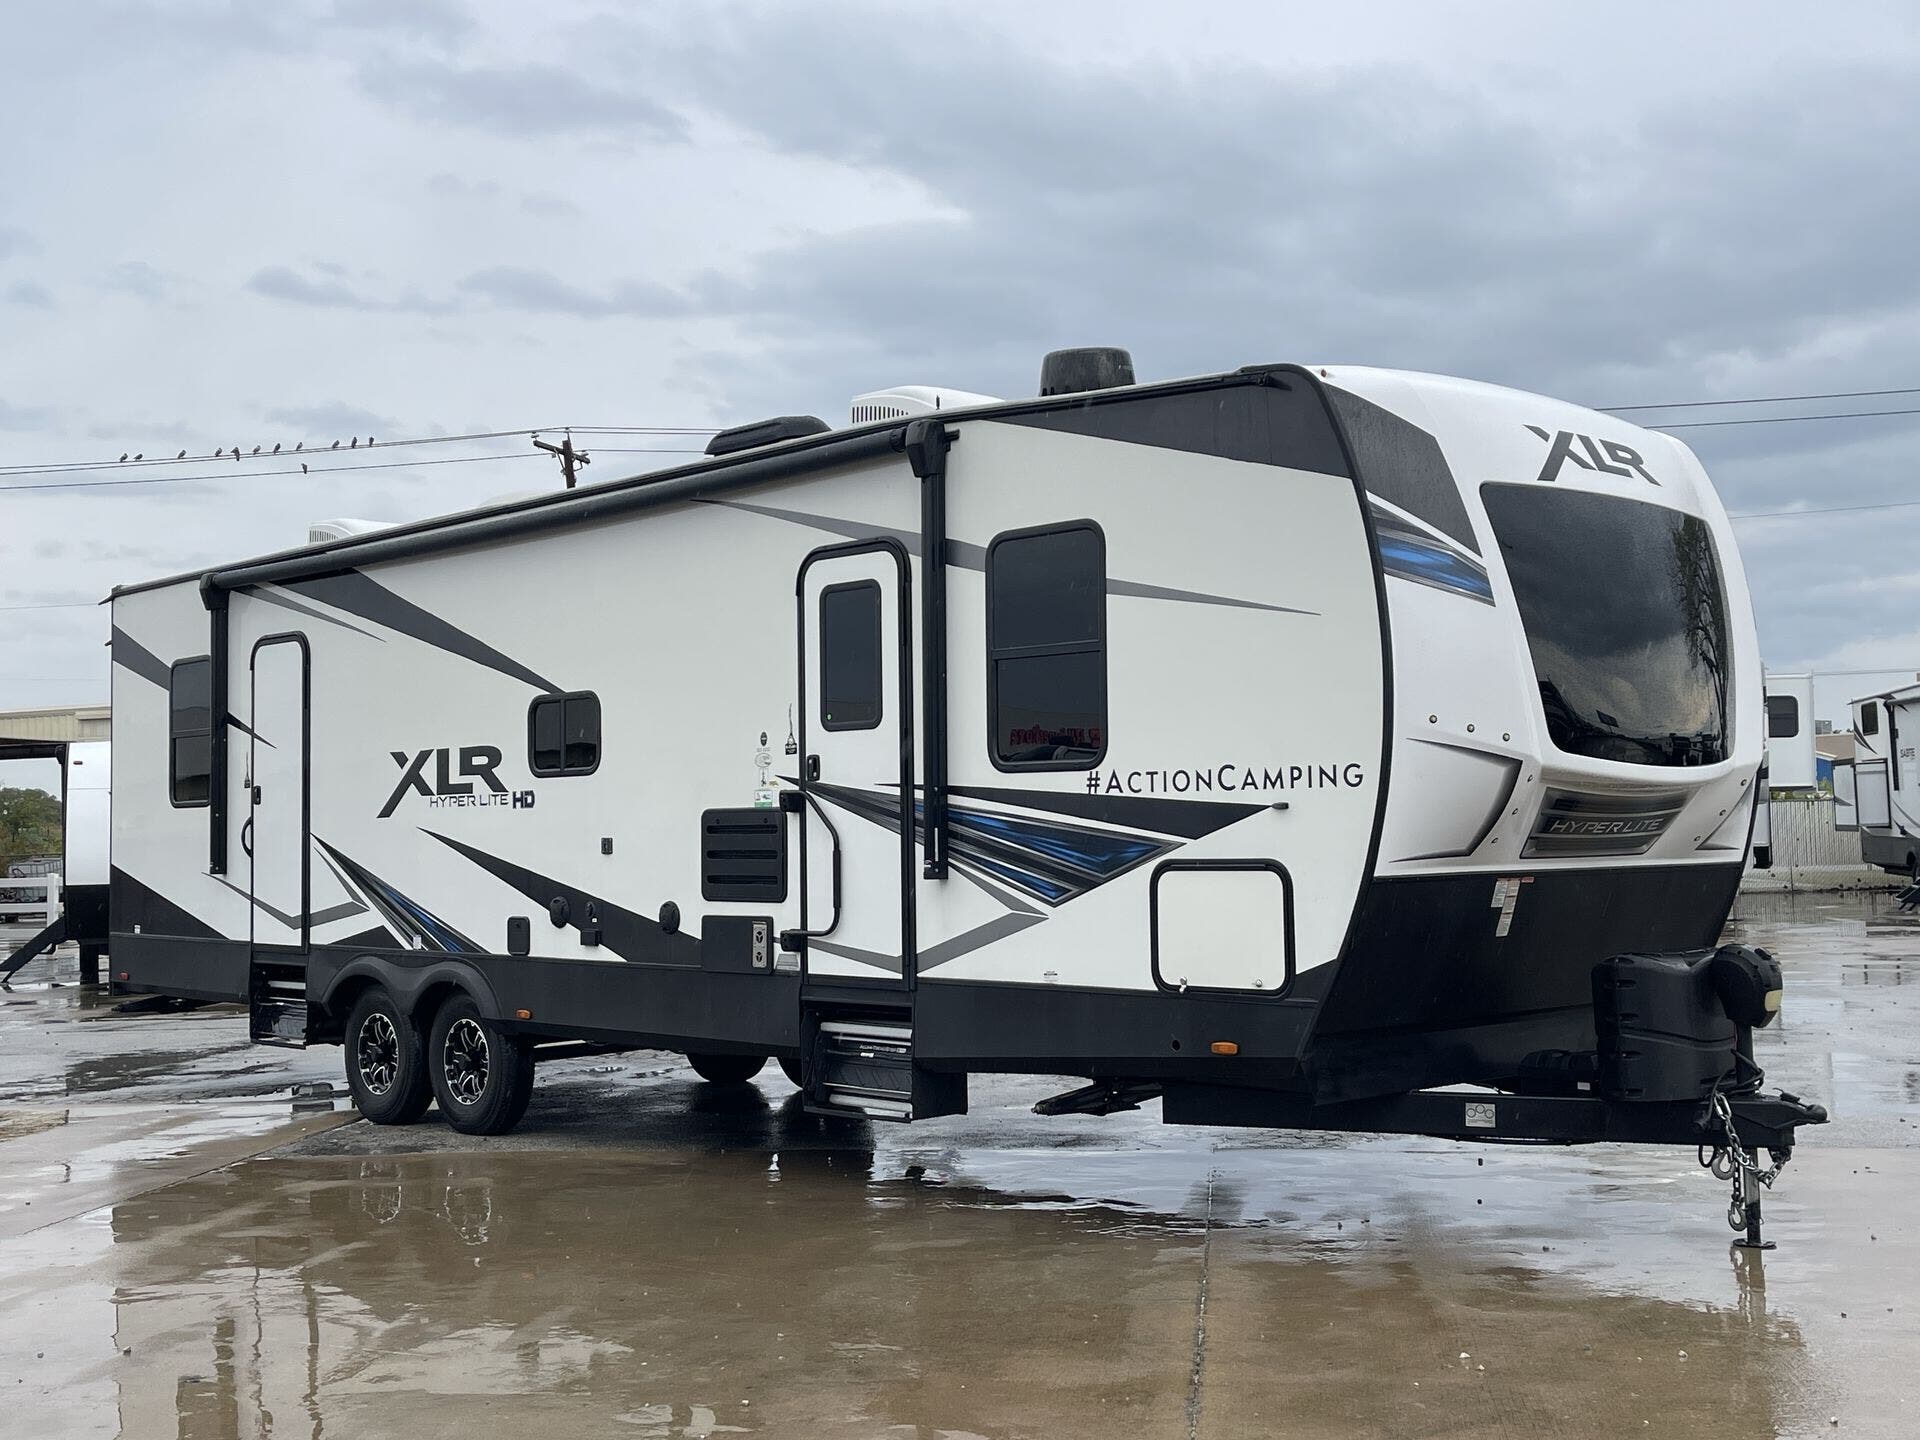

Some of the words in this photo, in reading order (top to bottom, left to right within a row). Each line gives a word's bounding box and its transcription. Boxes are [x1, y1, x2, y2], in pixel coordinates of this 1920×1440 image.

[1522, 424, 1663, 487] XLR
[376, 745, 509, 819] XLR
[512, 790, 535, 809] HD
